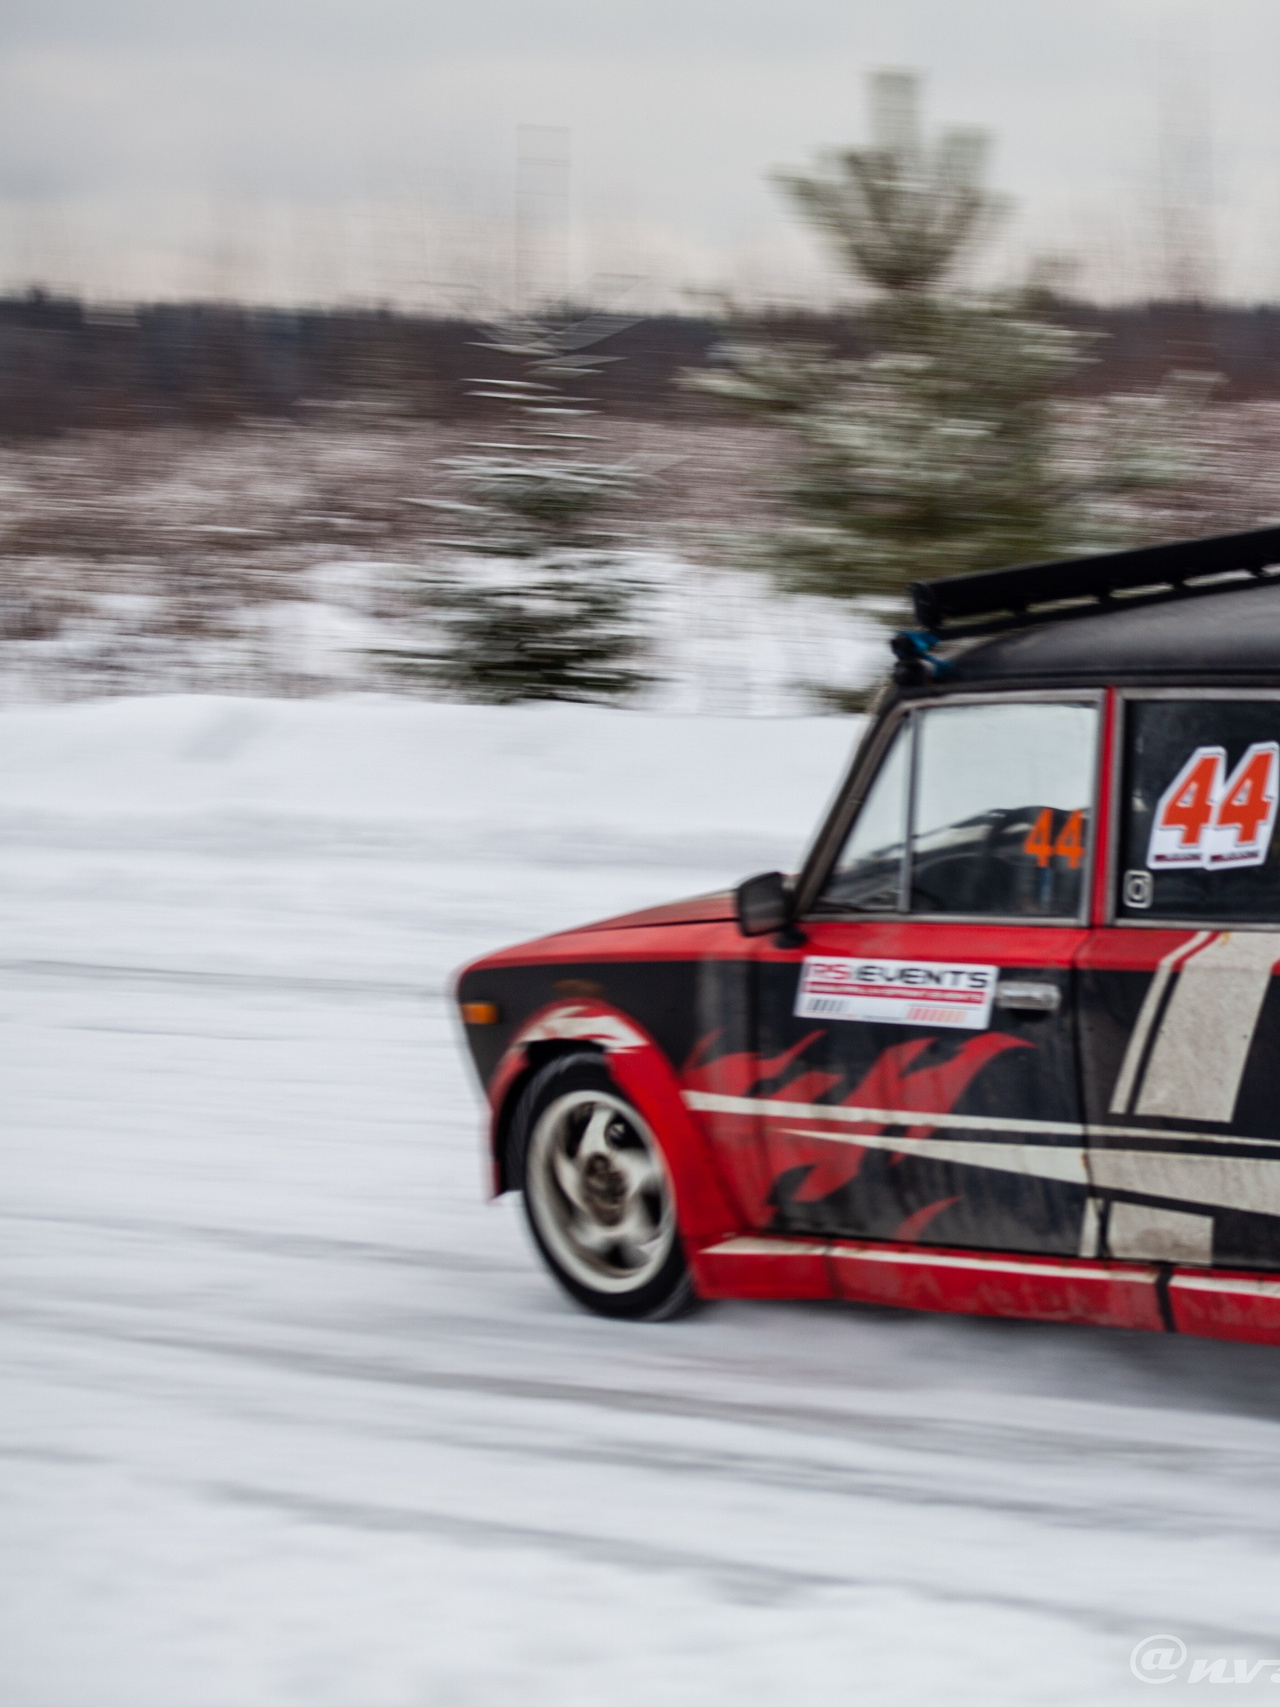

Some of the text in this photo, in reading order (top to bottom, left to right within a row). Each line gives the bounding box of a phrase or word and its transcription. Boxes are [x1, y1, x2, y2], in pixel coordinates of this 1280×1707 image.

[1159, 751, 1274, 846] 44
[1024, 808, 1084, 869] 44
[857, 965, 989, 988] EVENTS
